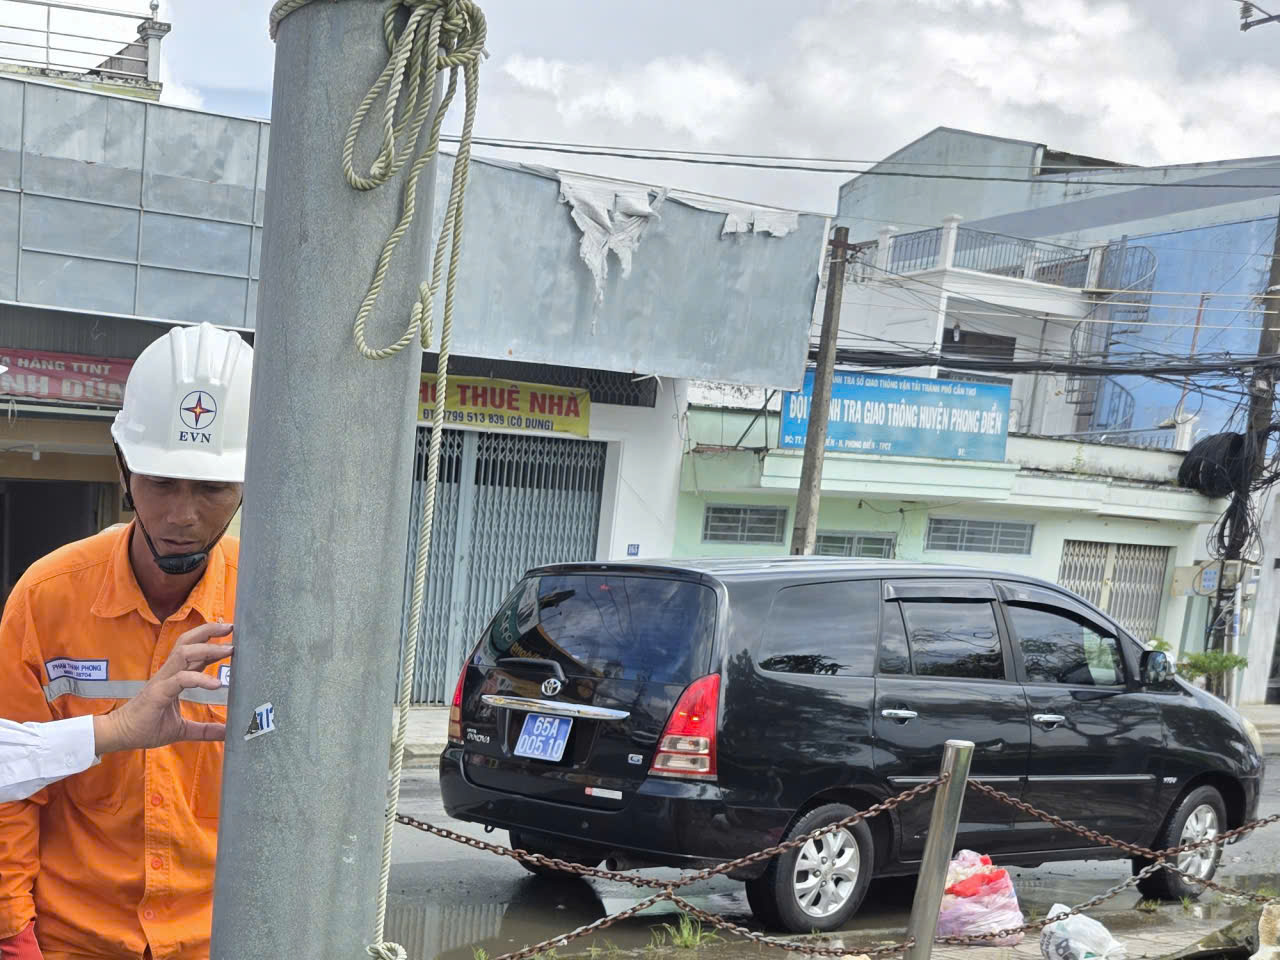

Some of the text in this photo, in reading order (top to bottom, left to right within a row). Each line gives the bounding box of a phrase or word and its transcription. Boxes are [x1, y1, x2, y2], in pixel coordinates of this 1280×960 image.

[17, 356, 66, 371] HÀNG
[71, 361, 113, 376] TTNT
[60, 377, 126, 400] DŨN
[456, 384, 520, 412] THUÊ
[528, 388, 581, 418] NHÀ
[466, 412, 486, 423] 513
[789, 394, 807, 424] ĐỘI
[843, 399, 862, 424] TRA
[863, 400, 885, 425] GIAO
[887, 398, 918, 428] THÔNG
[919, 401, 949, 433] HUYỆN
[949, 408, 979, 434] PHONG
[179, 430, 213, 444] EVN
[533, 716, 559, 736] 65A
[518, 735, 565, 758] 005.10
